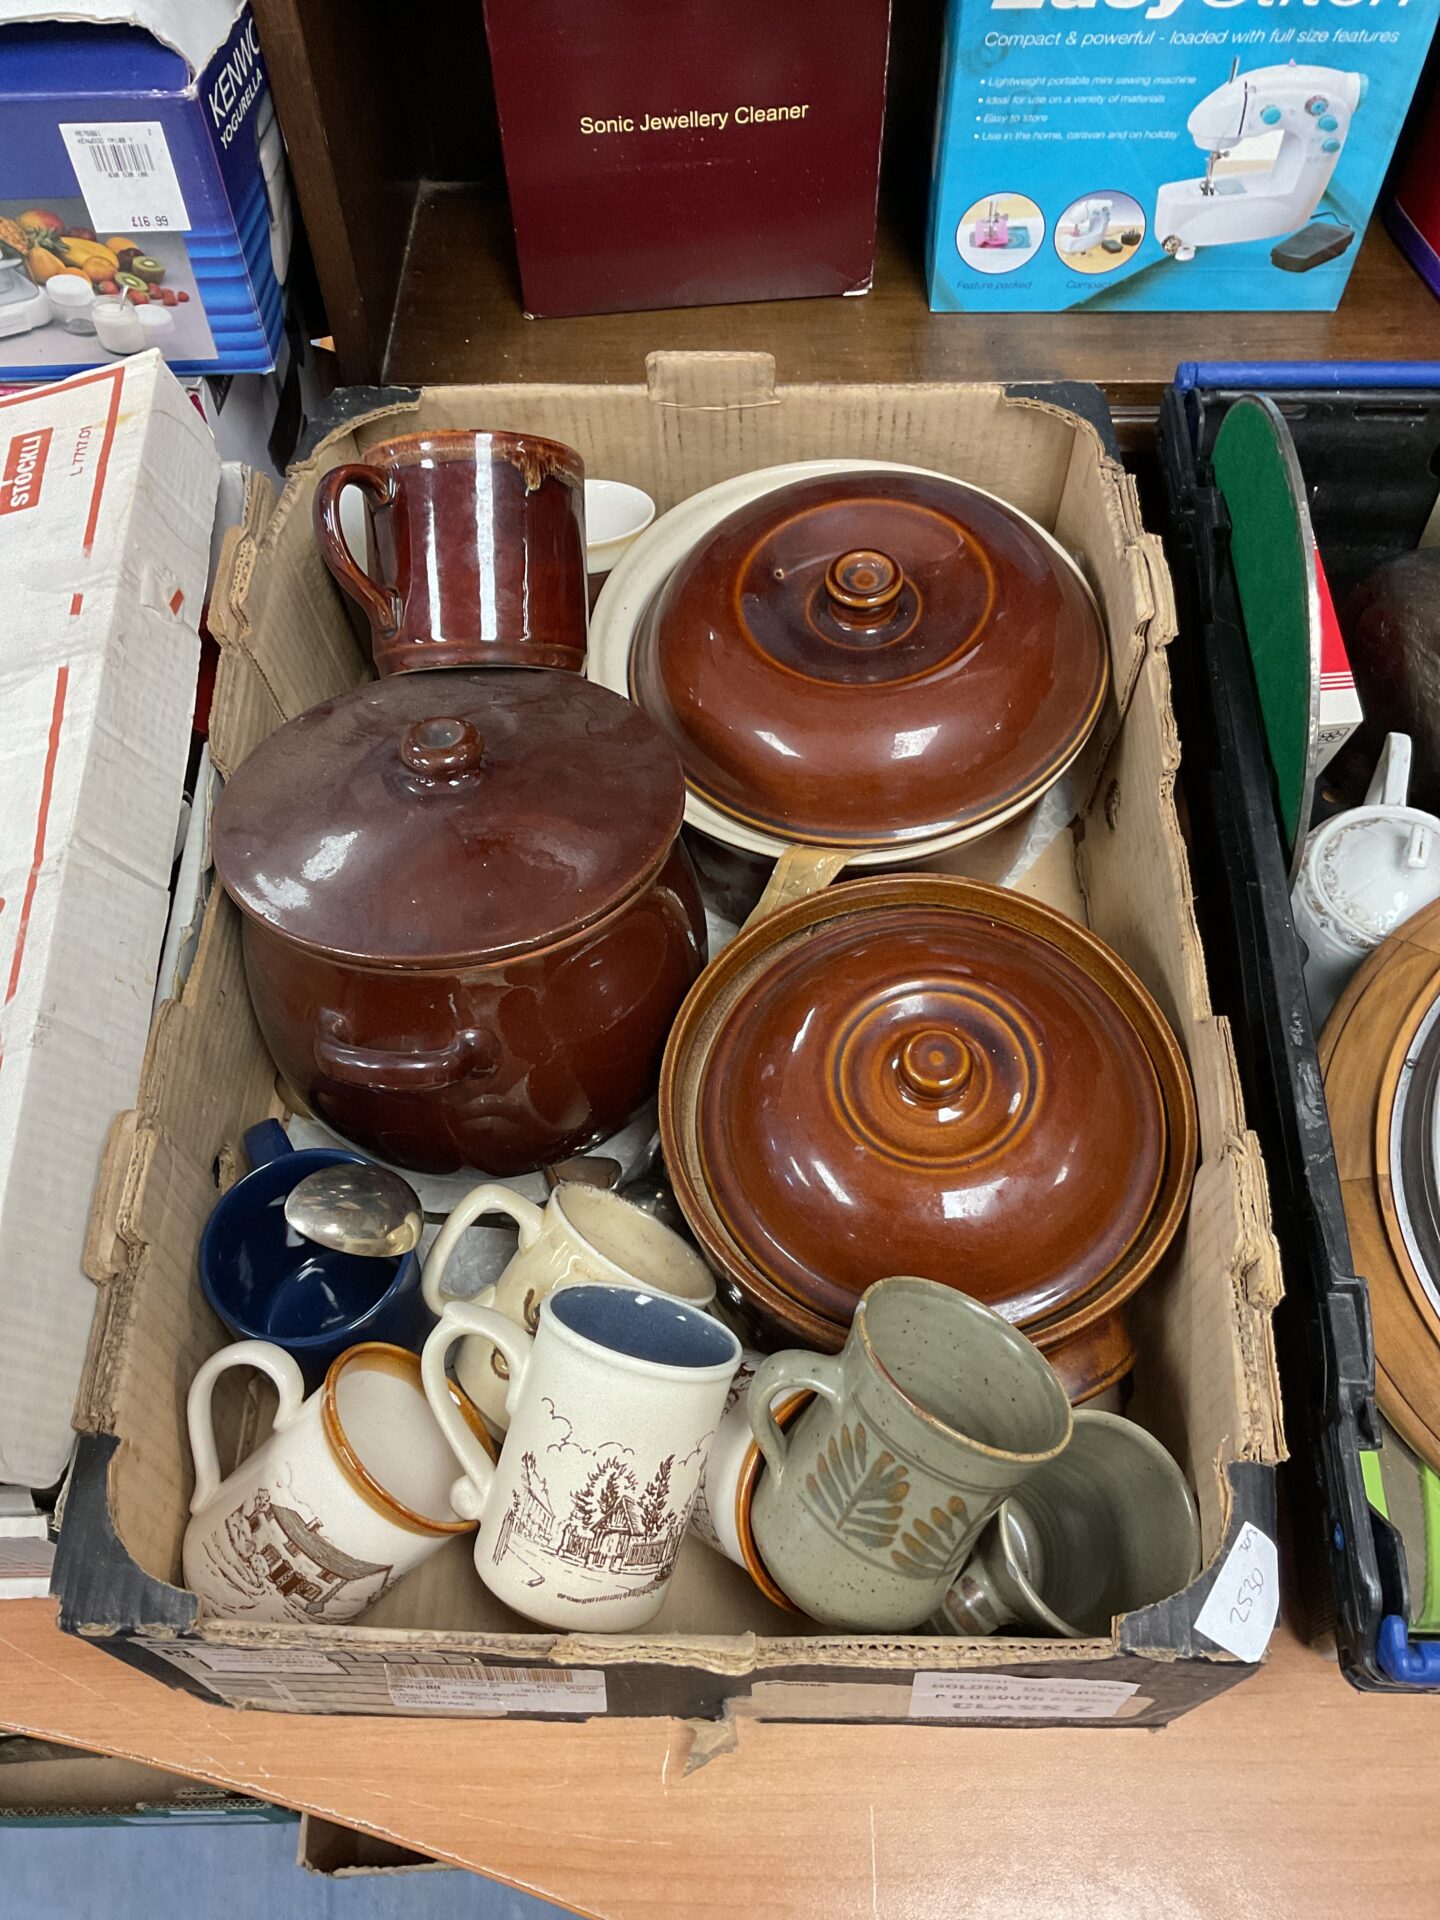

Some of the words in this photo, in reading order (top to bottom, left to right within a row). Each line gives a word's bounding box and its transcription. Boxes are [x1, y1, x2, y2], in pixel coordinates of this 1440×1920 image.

[985, 32, 1061, 48] Compact
[1065, 32, 1077, 46] &
[1081, 31, 1155, 48] powerful
[1169, 30, 1228, 45] loaded
[1232, 28, 1264, 43] with
[1268, 28, 1294, 43] full
[1297, 28, 1329, 43] size
[1332, 28, 1400, 43] features
[988, 77, 1046, 88] Lightweight
[1047, 76, 1090, 88] portable
[1091, 76, 1113, 85] mini
[1114, 76, 1152, 87] sewing
[1153, 75, 1197, 85] machine
[1073, 95, 1105, 106] variety
[1107, 95, 1120, 104] of
[1120, 95, 1167, 104] materials
[220, 67, 262, 150] YOGURELLA
[580, 115, 635, 135] Sonic
[639, 110, 730, 131] Jewellery
[734, 104, 810, 125] Cleaner
[983, 114, 1008, 124] Easy
[1010, 114, 1021, 122] to
[1022, 114, 1049, 123] store
[981, 132, 1002, 141] Use
[1003, 132, 1014, 140] in
[1015, 132, 1032, 140] the
[1065, 131, 1106, 140] caravan
[1107, 131, 1129, 140] and
[1128, 132, 1143, 140] on
[1144, 130, 1180, 142] holiday
[956, 279, 994, 290] Feature
[995, 279, 1033, 291] packed
[1230, 1567, 1264, 1625] 2530
